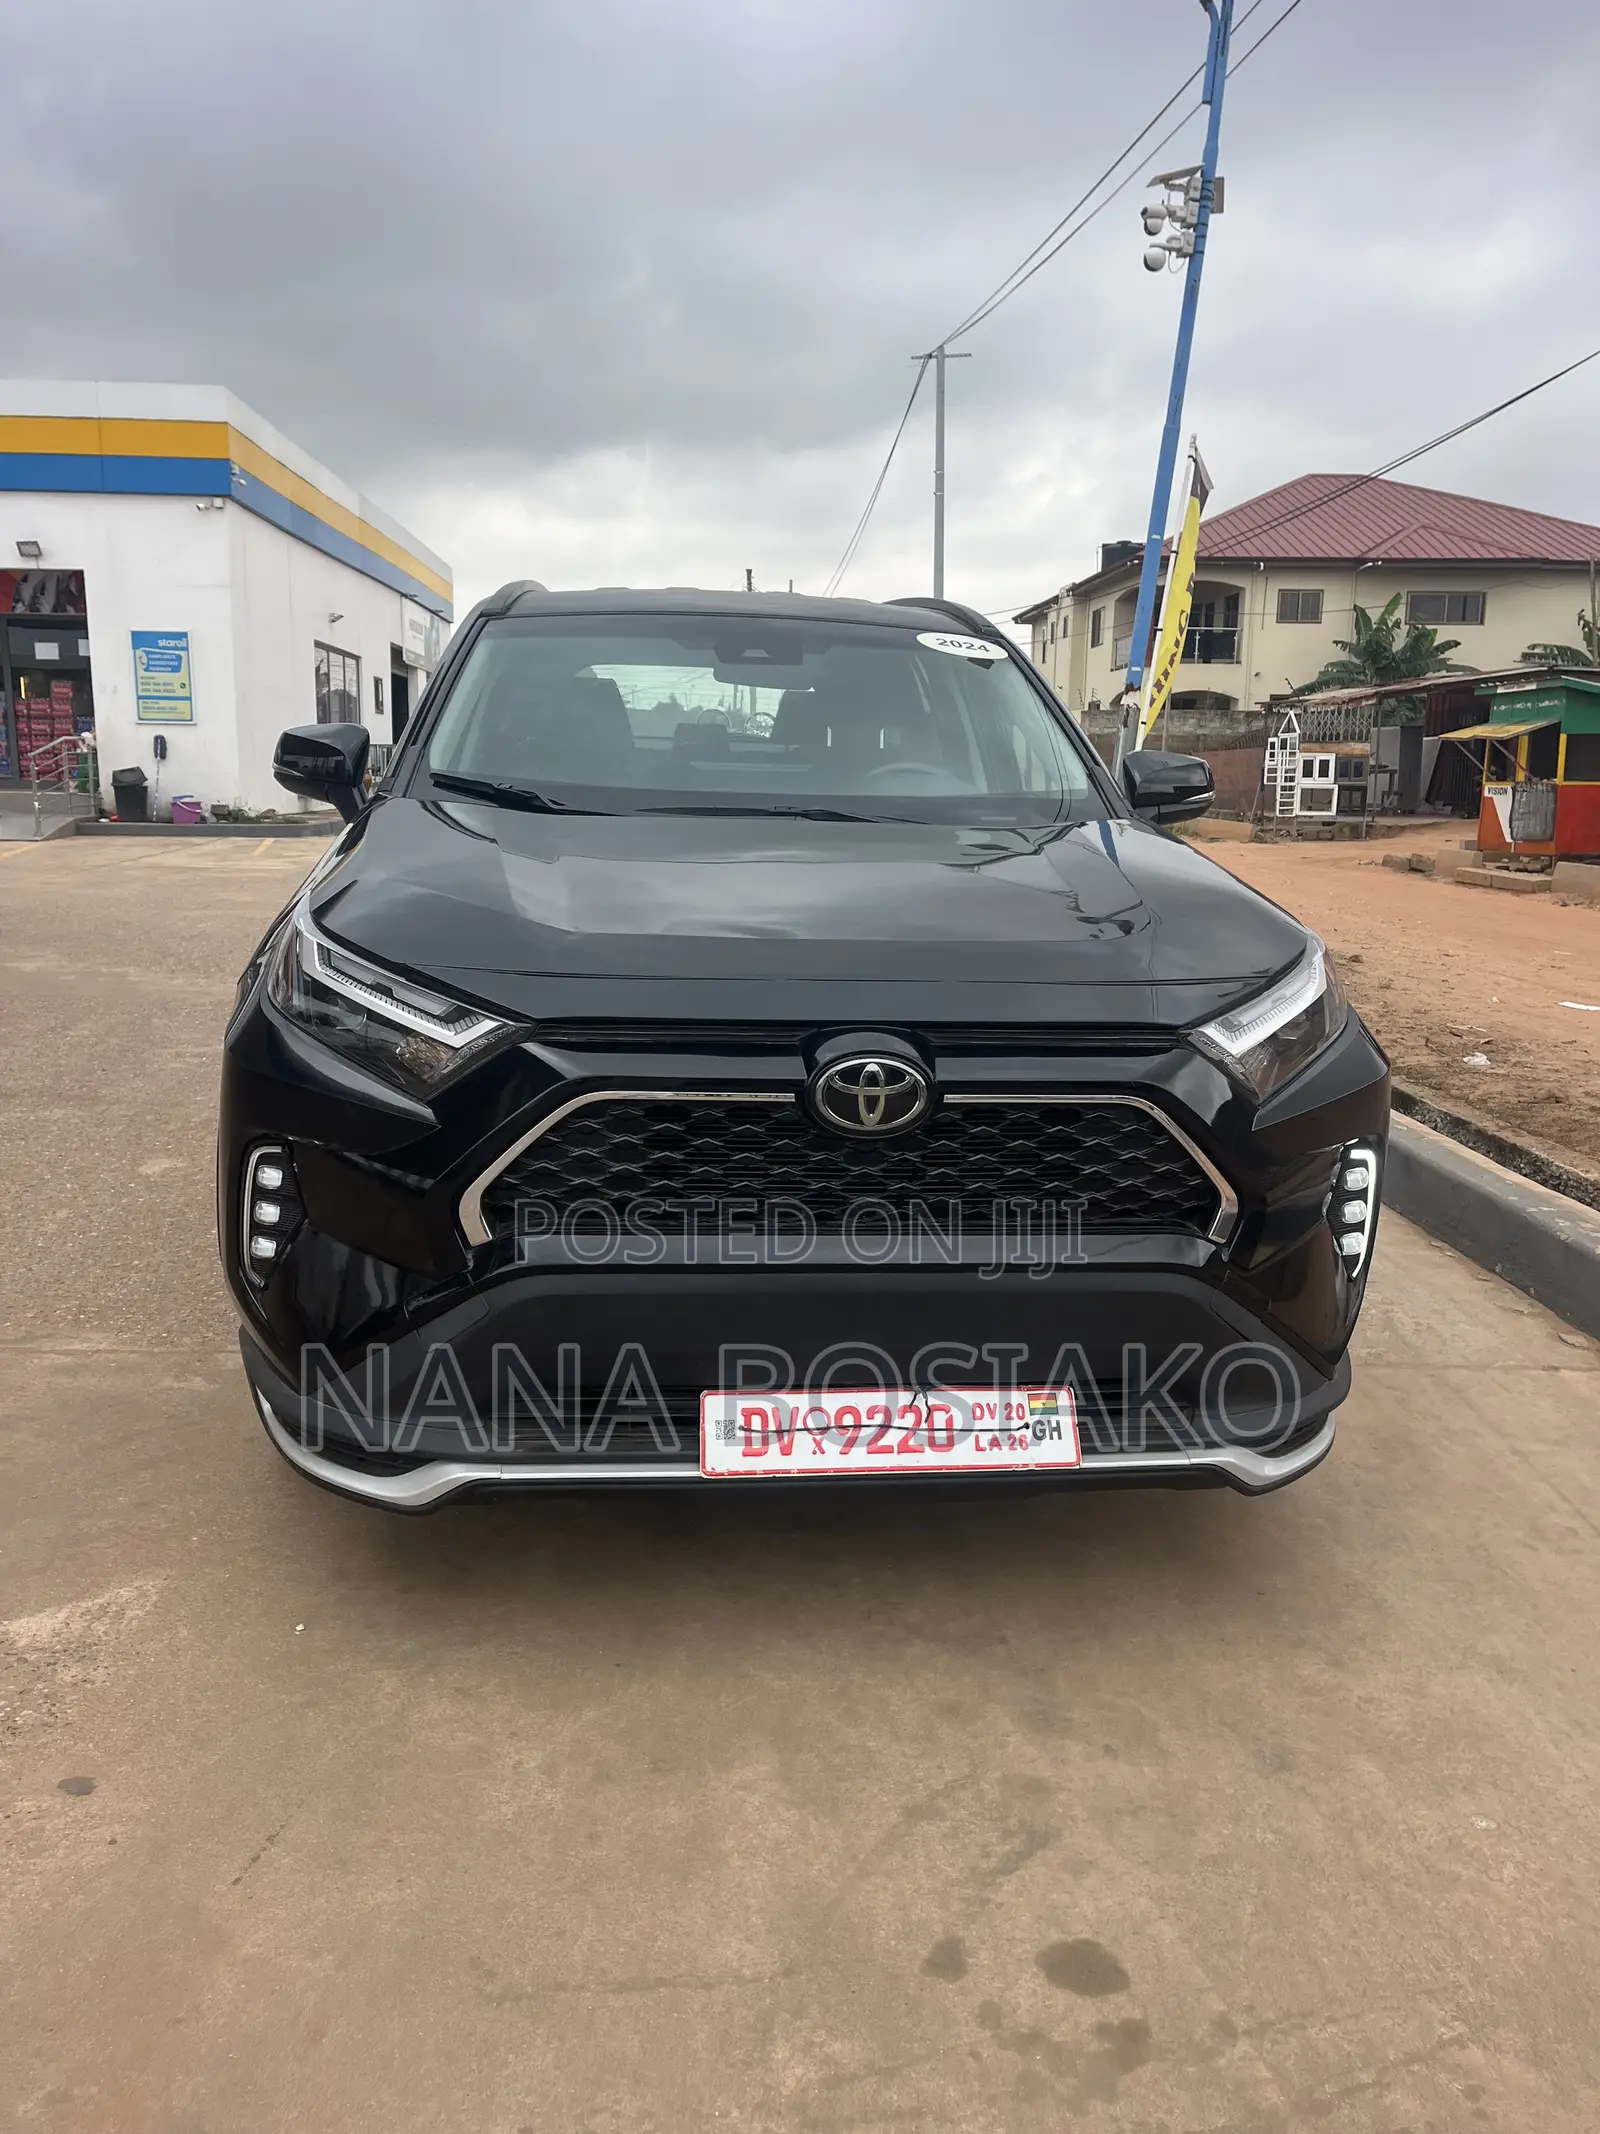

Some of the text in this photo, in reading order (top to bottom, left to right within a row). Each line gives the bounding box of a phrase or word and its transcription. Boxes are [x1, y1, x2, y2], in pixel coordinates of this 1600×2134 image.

[158, 637, 187, 647] staroil
[936, 638, 991, 652] 2024
[1487, 786, 1508, 796] VISION
[971, 1402, 1026, 1421] DV 20
[741, 1403, 955, 1458] DV 9220
[1031, 1419, 1063, 1441] GH
[974, 1433, 1029, 1452] LA 26
